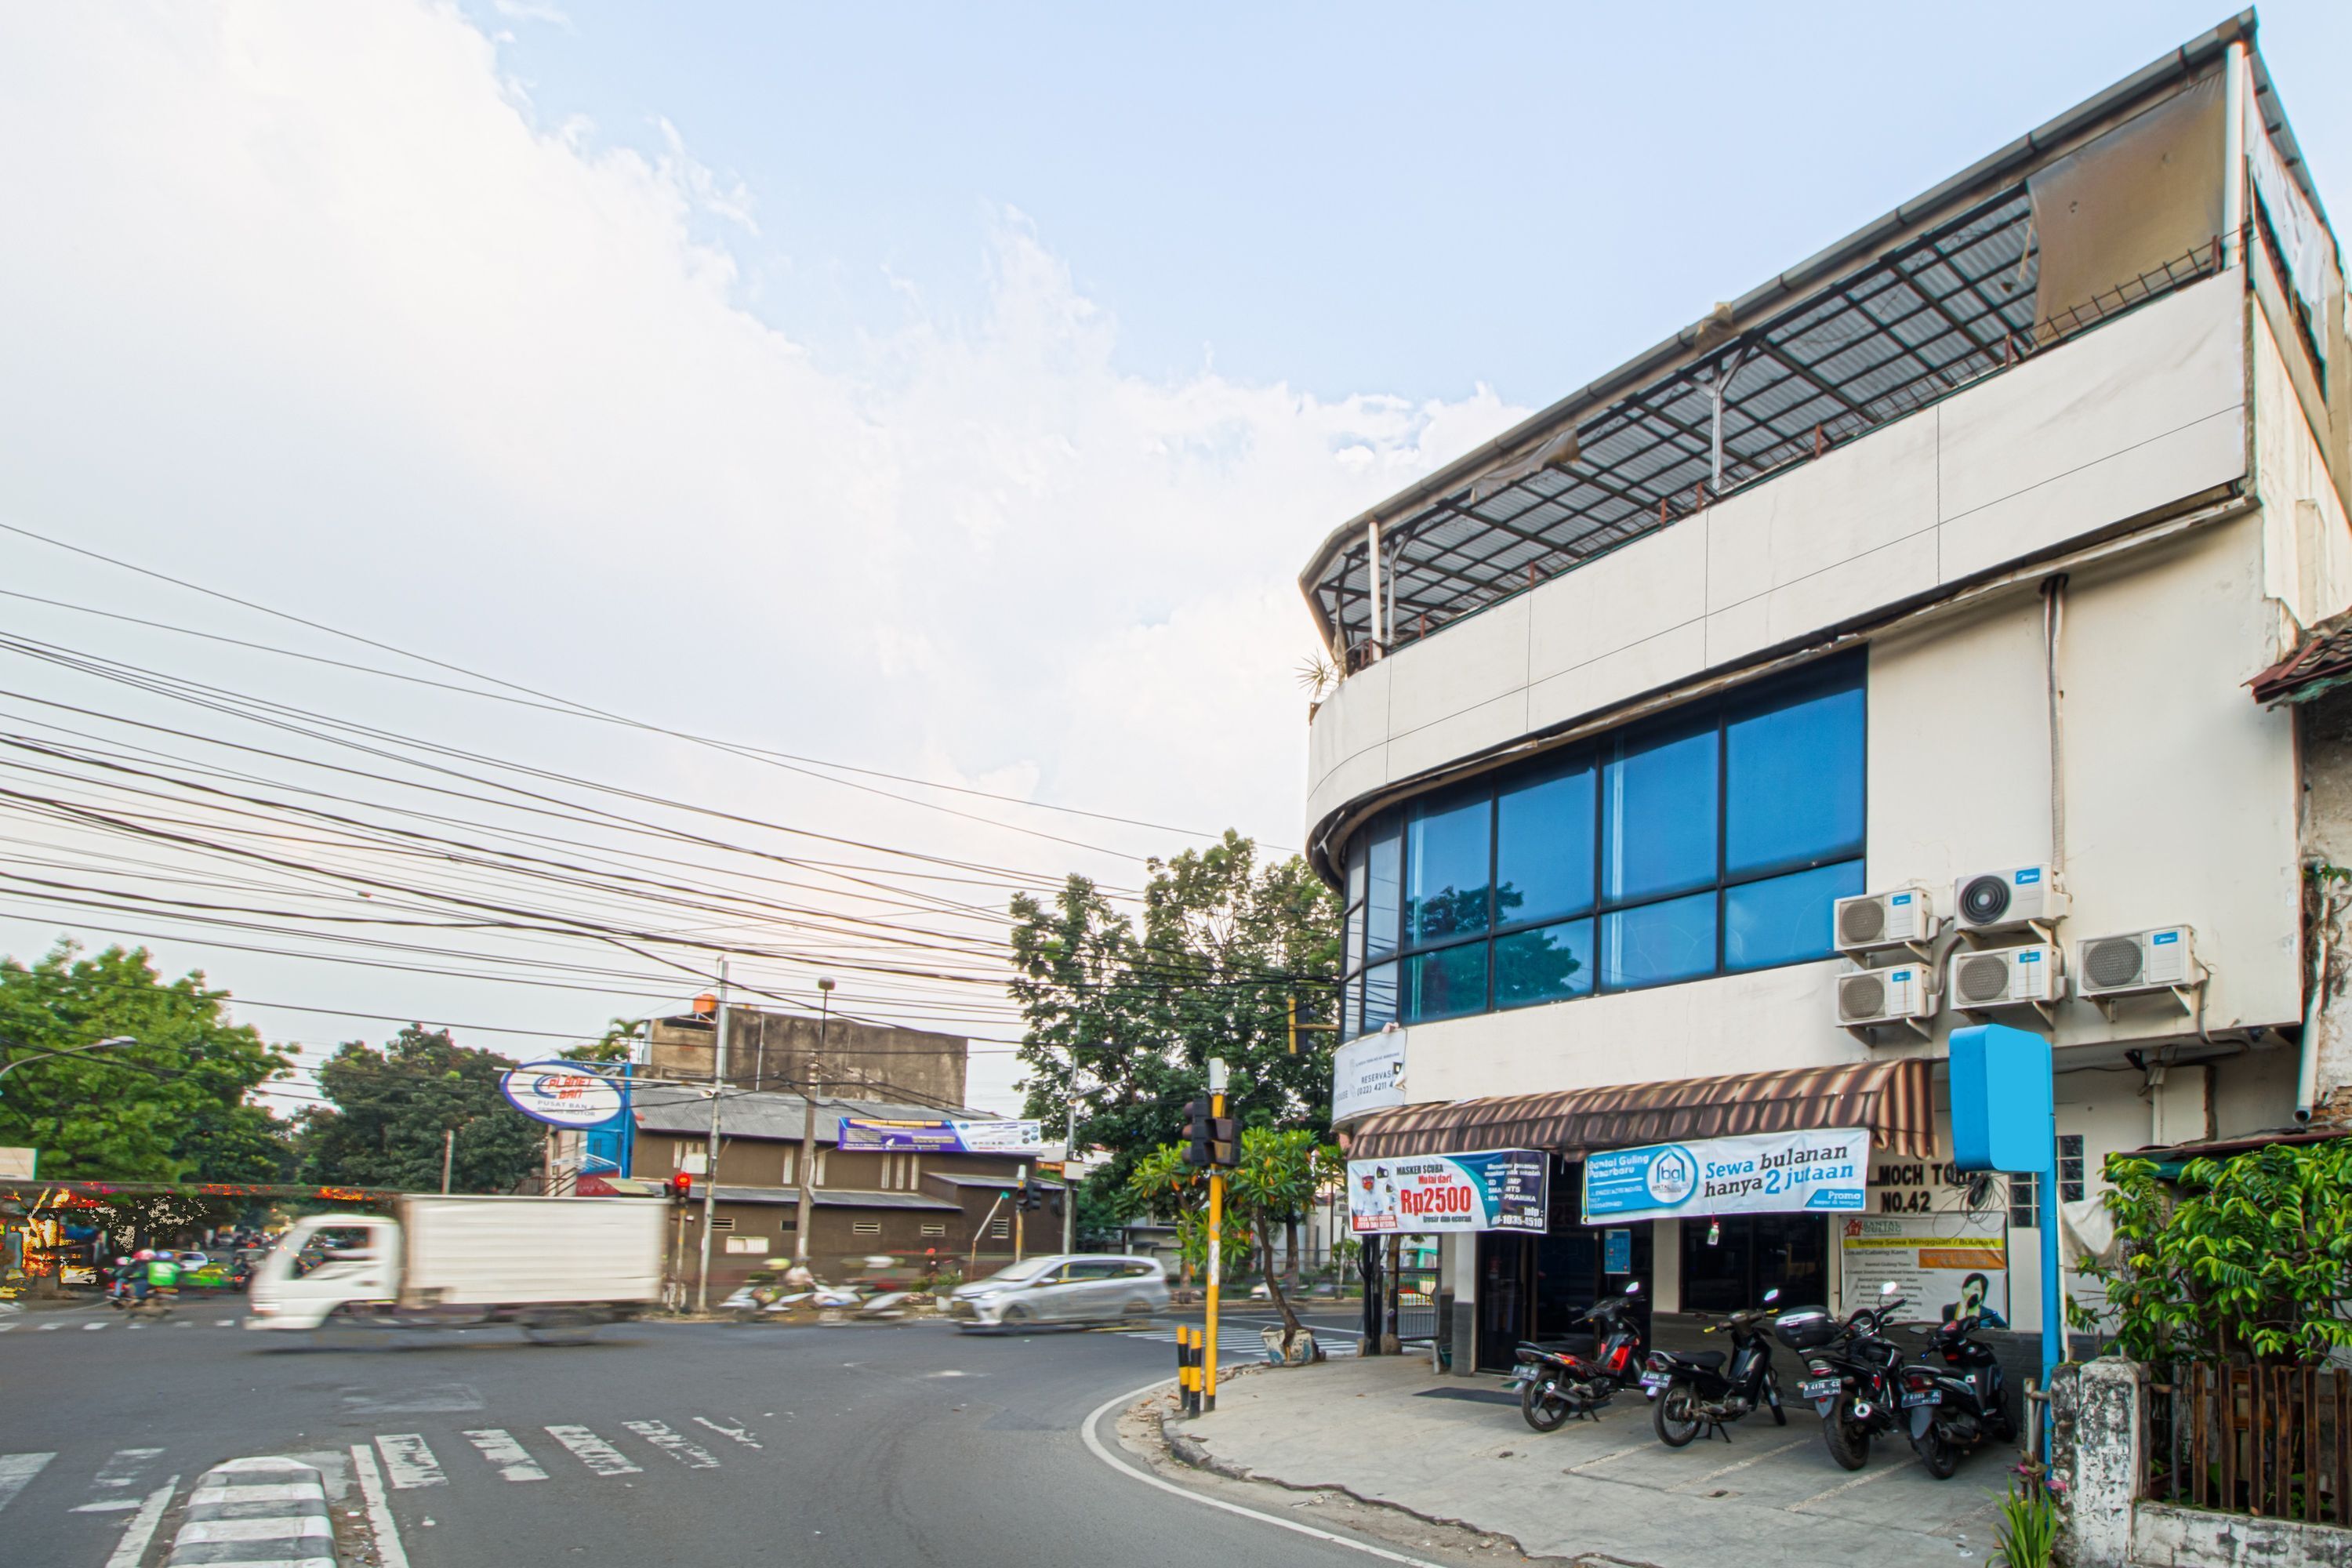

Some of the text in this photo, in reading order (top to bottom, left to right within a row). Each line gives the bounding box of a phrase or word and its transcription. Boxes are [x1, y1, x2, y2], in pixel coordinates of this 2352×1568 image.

[547, 1075, 593, 1090] PLANET
[558, 1089, 583, 1100] BAN
[1356, 1085, 1372, 1097] (022)
[1396, 1164, 1443, 1175] MASKER SCUBA
[1588, 1155, 1650, 1170] Bantal Guling
[1705, 1145, 1848, 1180] Sewa bulanan
[1417, 1174, 1452, 1185] Mulai dari
[1661, 1166, 1681, 1182] bg
[1704, 1161, 1854, 1198] hanya 2 jutaan
[1400, 1185, 1472, 1217] Rp2500
[1828, 1190, 1861, 1200] Promo
[1881, 1190, 1931, 1214] NO.42
[1908, 1238, 1951, 1247] Mingguan
